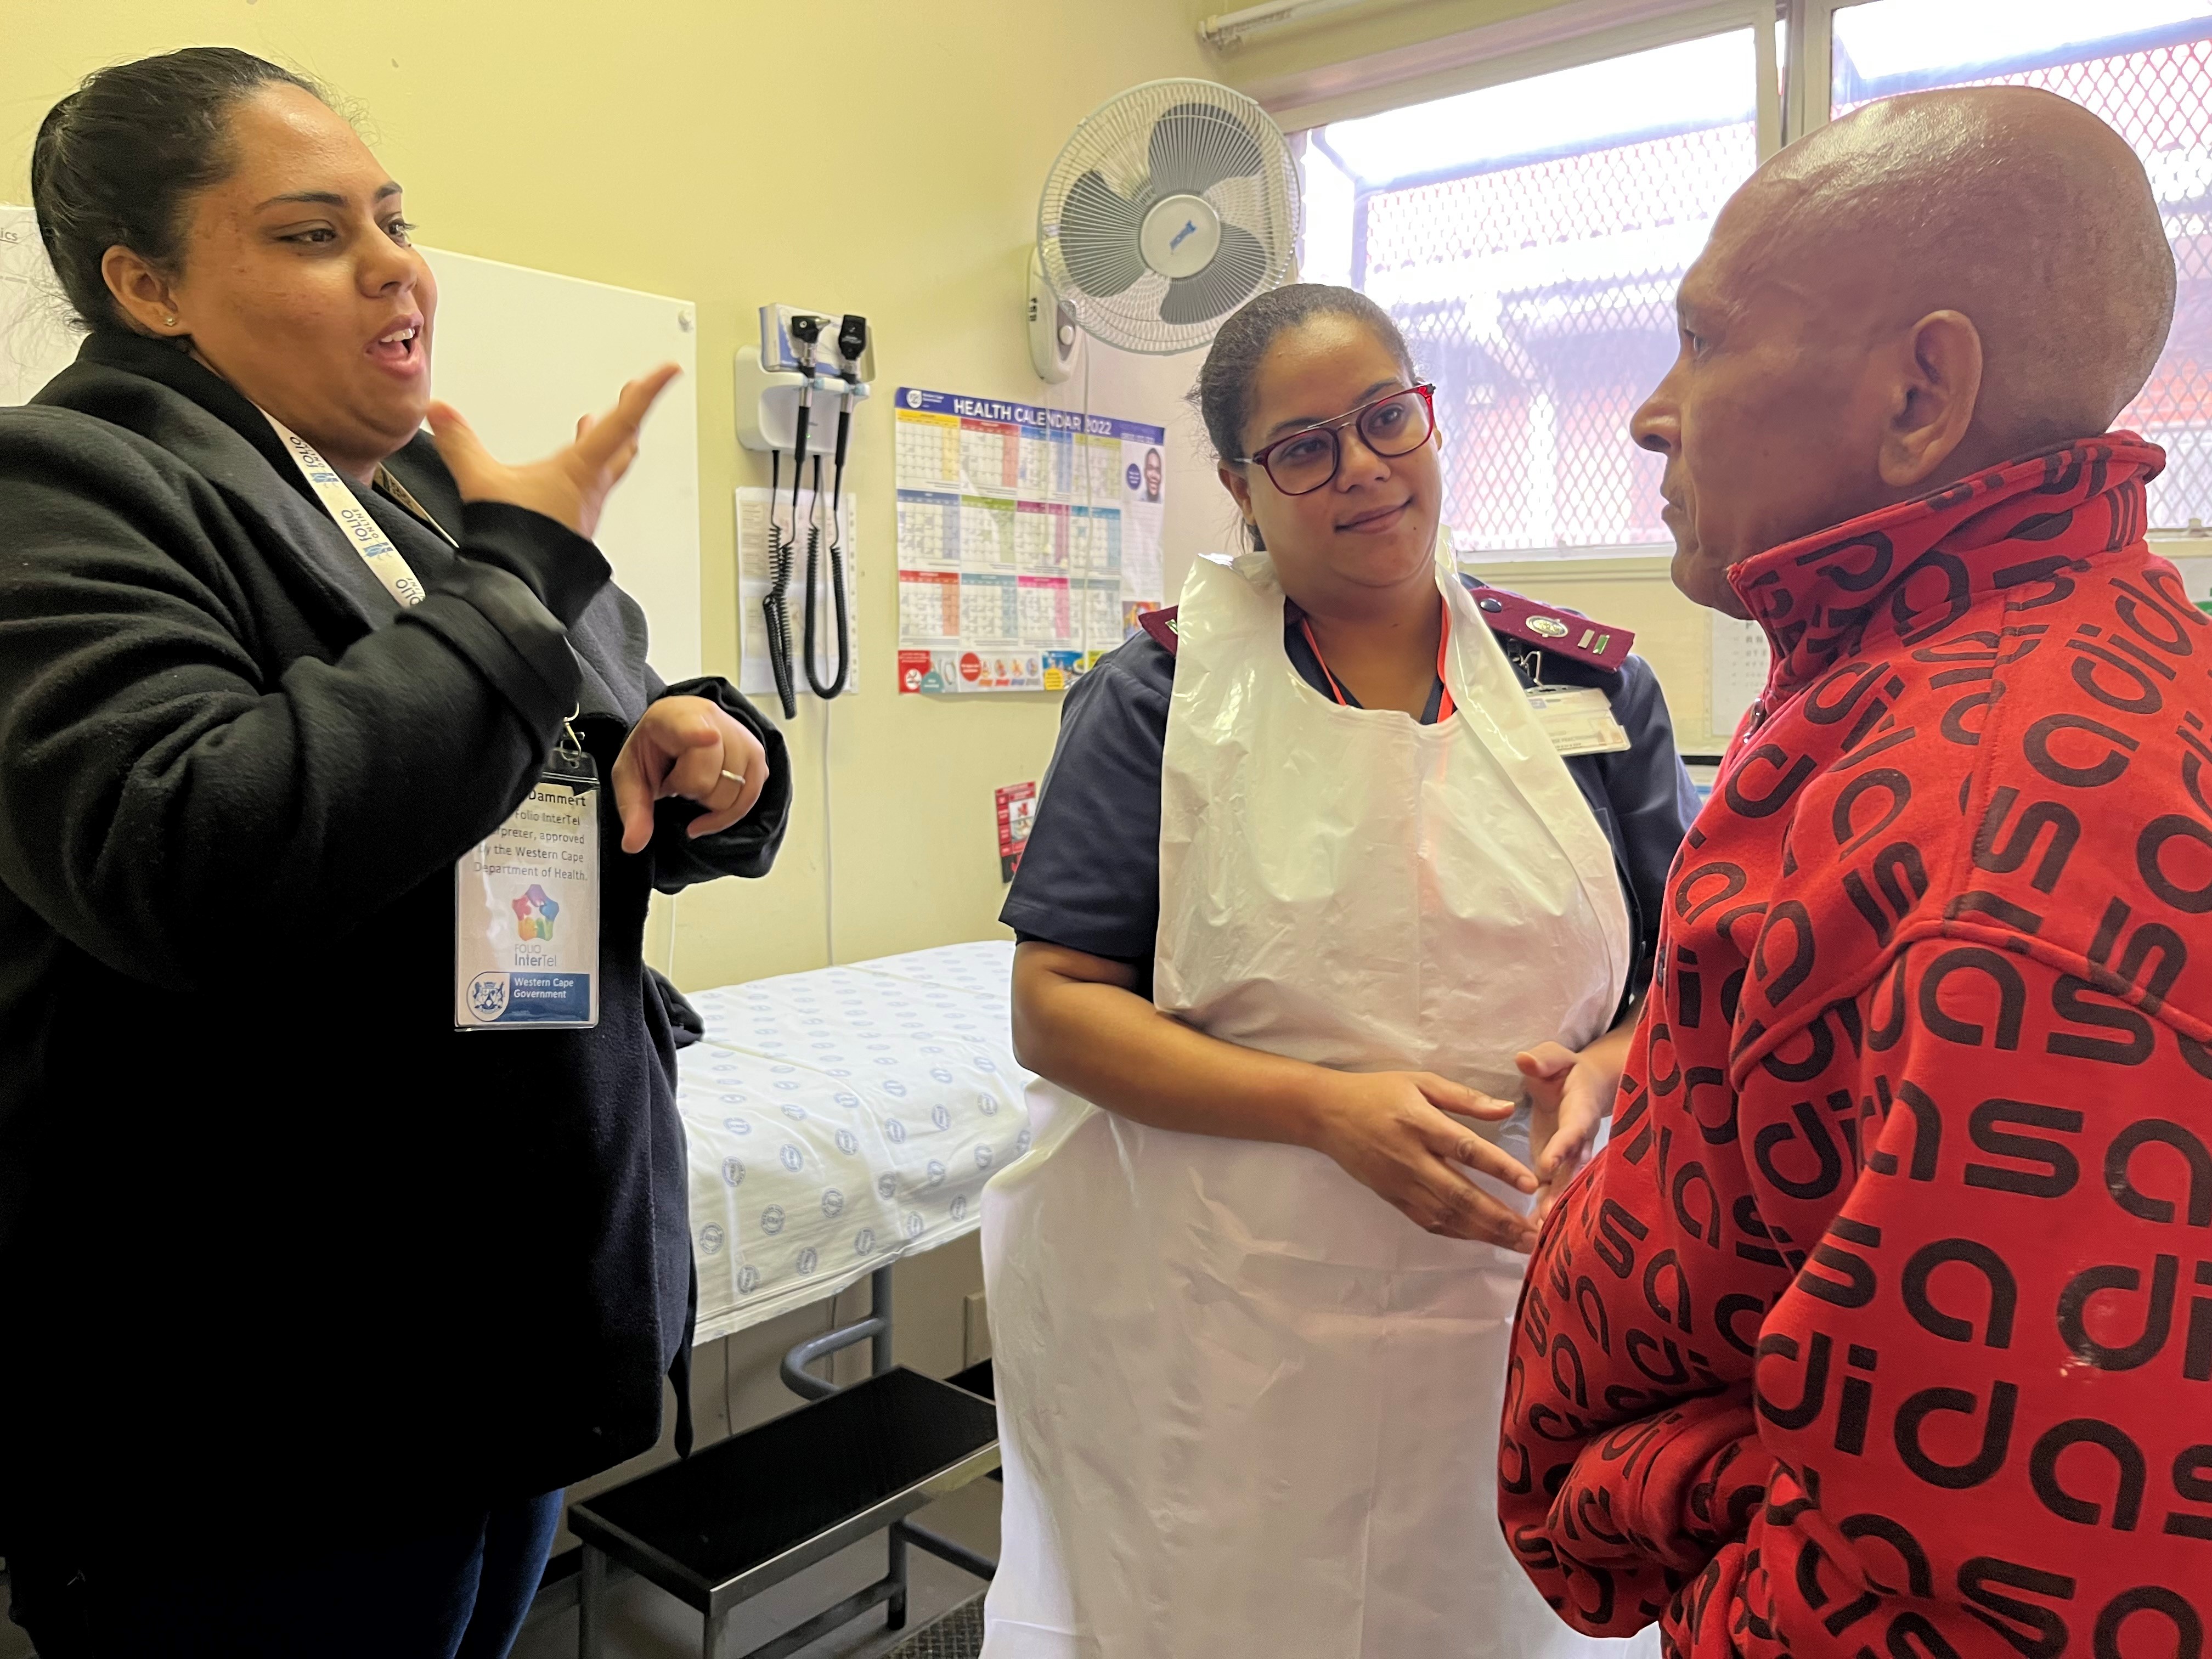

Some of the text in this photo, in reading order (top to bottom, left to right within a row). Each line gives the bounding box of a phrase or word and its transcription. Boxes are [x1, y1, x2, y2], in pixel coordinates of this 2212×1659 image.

[953, 399, 1012, 421] HEALTH
[1014, 407, 1082, 431] CALENDAR
[1085, 417, 1113, 437] 2022
[342, 510, 371, 541] FOLIO
[352, 508, 380, 539] ONLINE
[396, 579, 420, 606] OLIO
[529, 789, 586, 807] Dammert
[515, 809, 580, 826] Folio InterTel
[540, 833, 585, 845] approved
[494, 844, 512, 856] the
[515, 847, 558, 860] Western
[561, 851, 584, 863] Cape
[474, 861, 588, 882] Department of Health.
[515, 944, 541, 954] FOLIO
[515, 954, 557, 967] InterTel
[514, 977, 574, 990] Western Cape
[514, 989, 567, 999] Government
